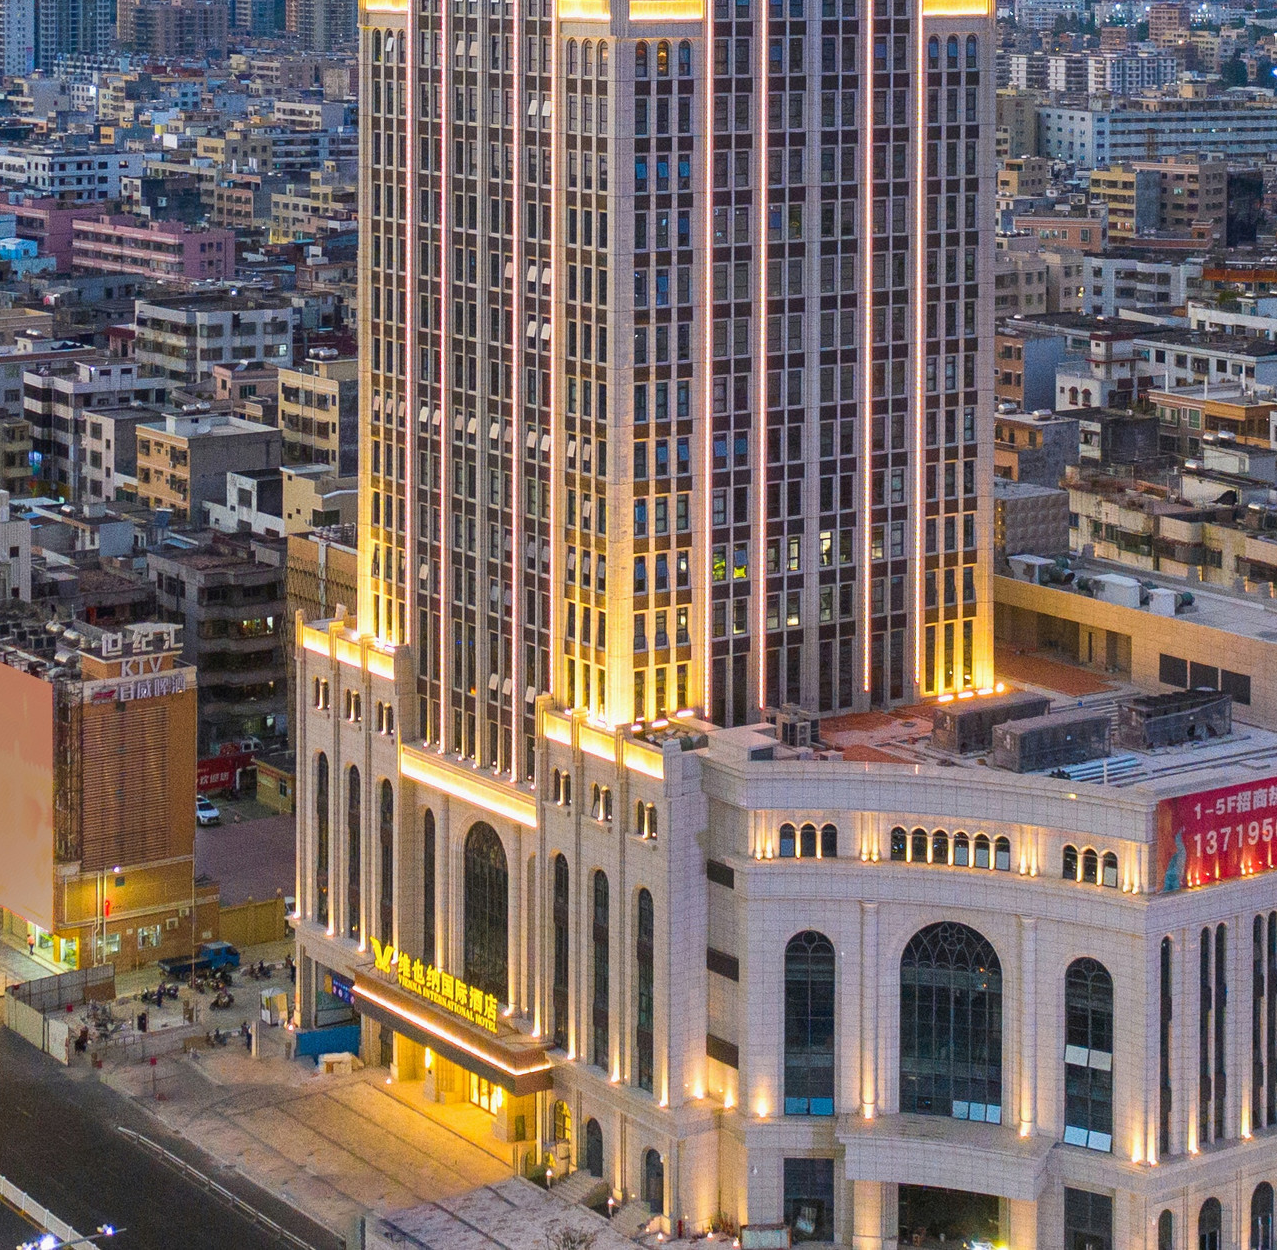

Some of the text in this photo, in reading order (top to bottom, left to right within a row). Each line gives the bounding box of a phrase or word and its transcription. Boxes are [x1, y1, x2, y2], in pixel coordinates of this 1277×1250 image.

[102, 624, 183, 656] 世纪汇
[121, 656, 163, 677] KTV
[120, 671, 186, 702] 百威啤酒
[398, 951, 499, 1021] 维也纳国际酒店
[398, 975, 498, 1034] VIENNA INTERNATIONAL HOTEL
